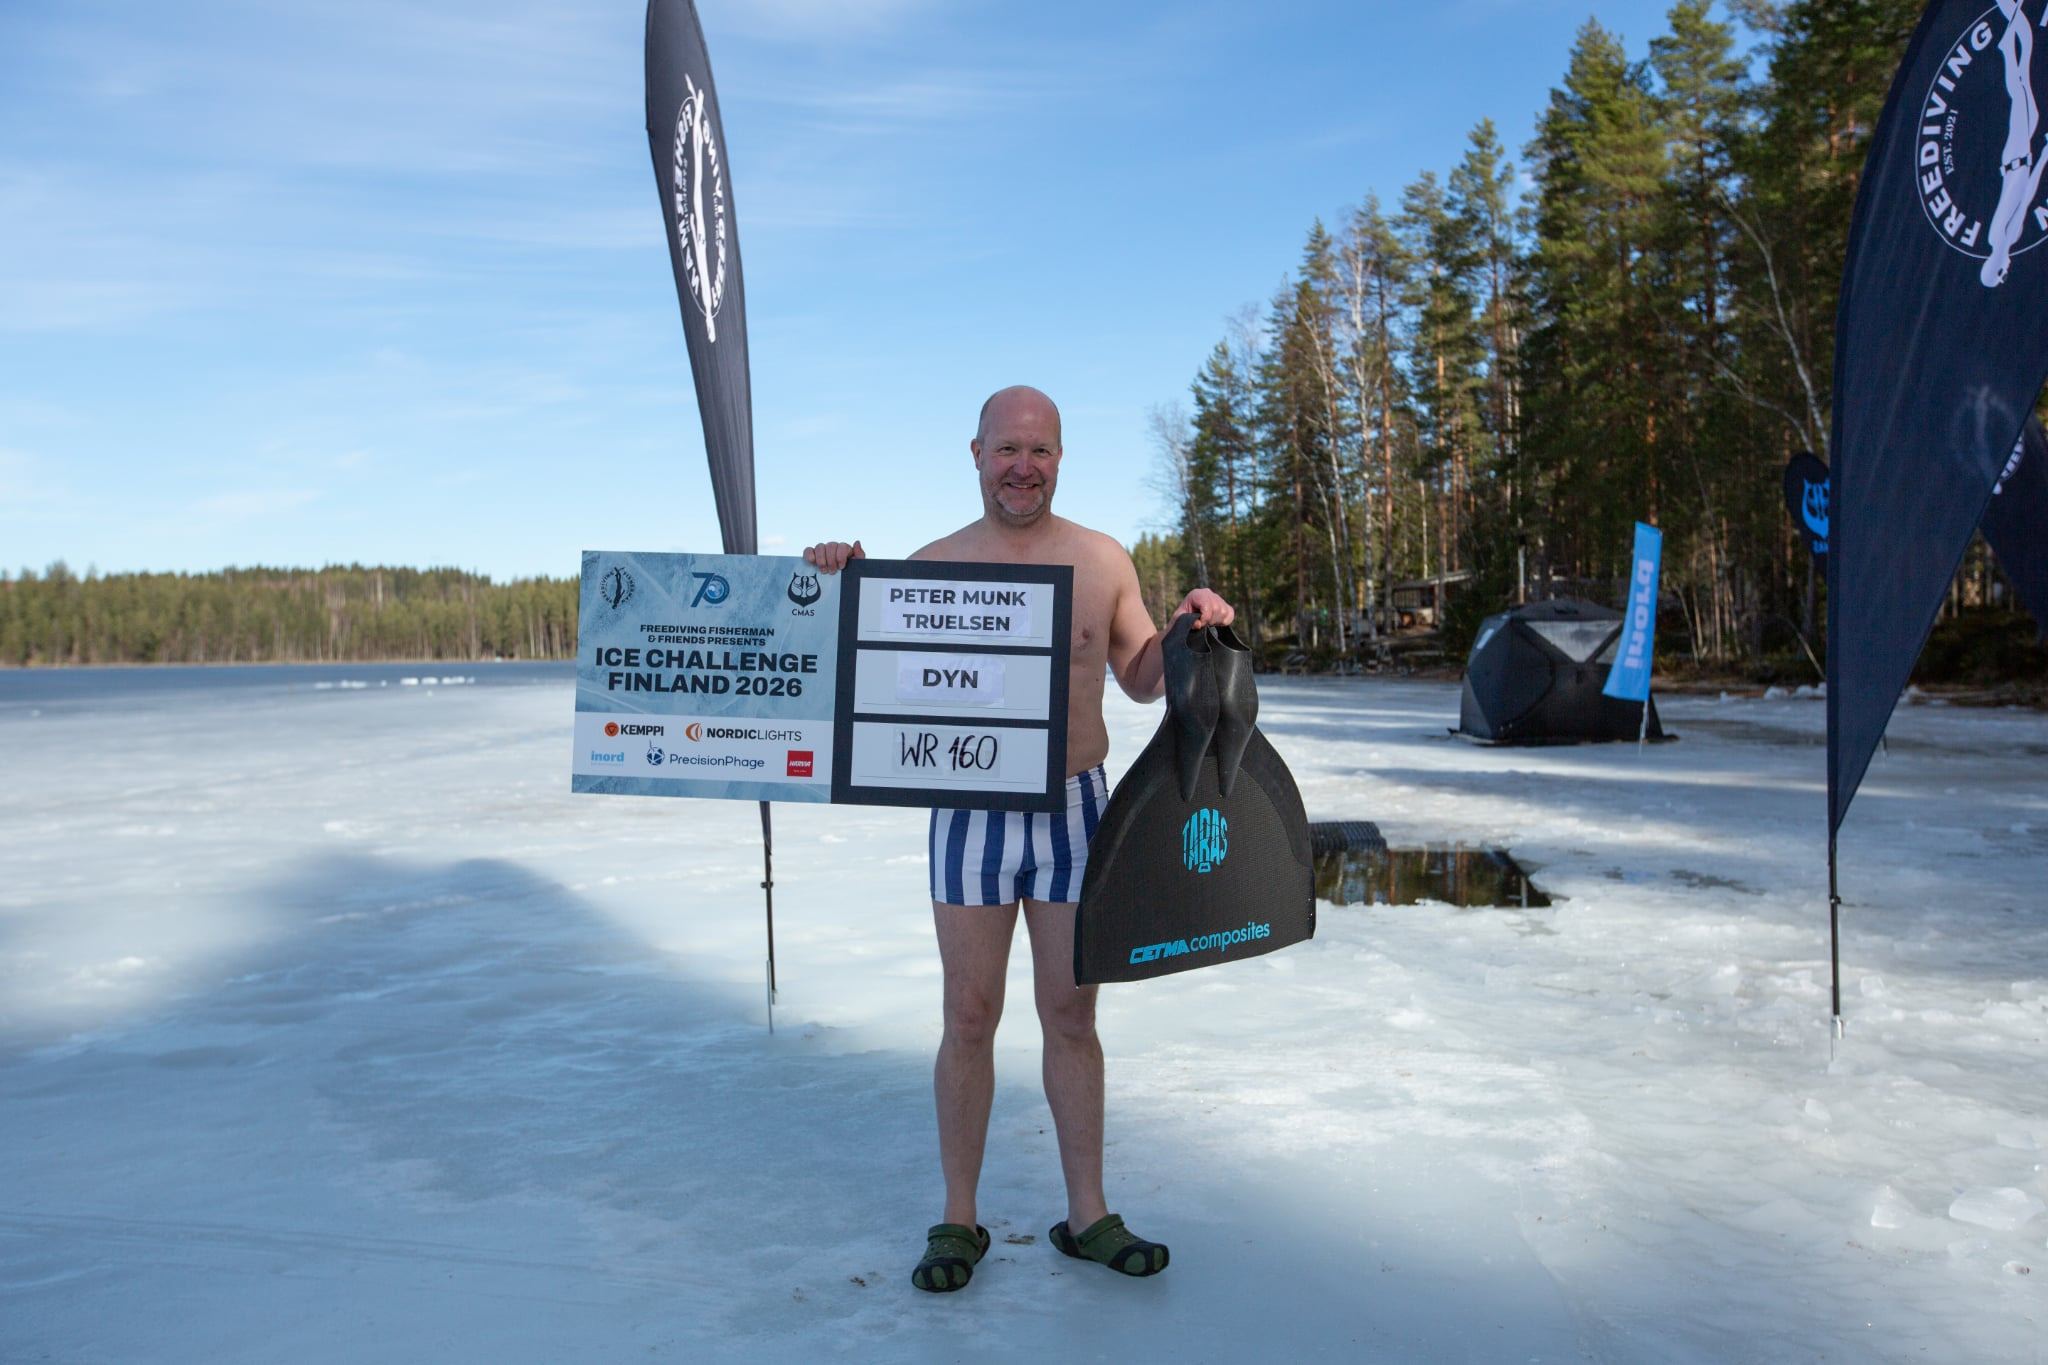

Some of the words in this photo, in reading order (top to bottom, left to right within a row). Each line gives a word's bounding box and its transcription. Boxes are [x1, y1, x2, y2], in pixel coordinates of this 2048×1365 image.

[1943, 109, 1958, 140] 2021
[1920, 21, 1993, 248] FREEDIVING
[1943, 142, 1954, 175] EST.
[890, 588, 955, 604] PETER
[962, 590, 1026, 606] MUNK
[640, 624, 706, 634] FREEDIVING
[708, 627, 774, 636] FISHERMAN
[903, 613, 1010, 631] TRUELSEN
[648, 635, 656, 643] &
[658, 636, 705, 644] FRIENDS
[708, 637, 766, 646] PRESENTS
[596, 648, 640, 667] ICE
[646, 650, 818, 673] CHALLENGE
[608, 672, 729, 694] FINLAND
[735, 677, 802, 697] 2026
[922, 669, 979, 688] DYN
[621, 724, 664, 736] KEMPPI
[707, 728, 802, 741] NORDICLIGHTS
[591, 751, 624, 762] inord
[901, 732, 938, 767] WR
[948, 734, 998, 771] 160
[670, 754, 764, 769] PrecisionPhage
